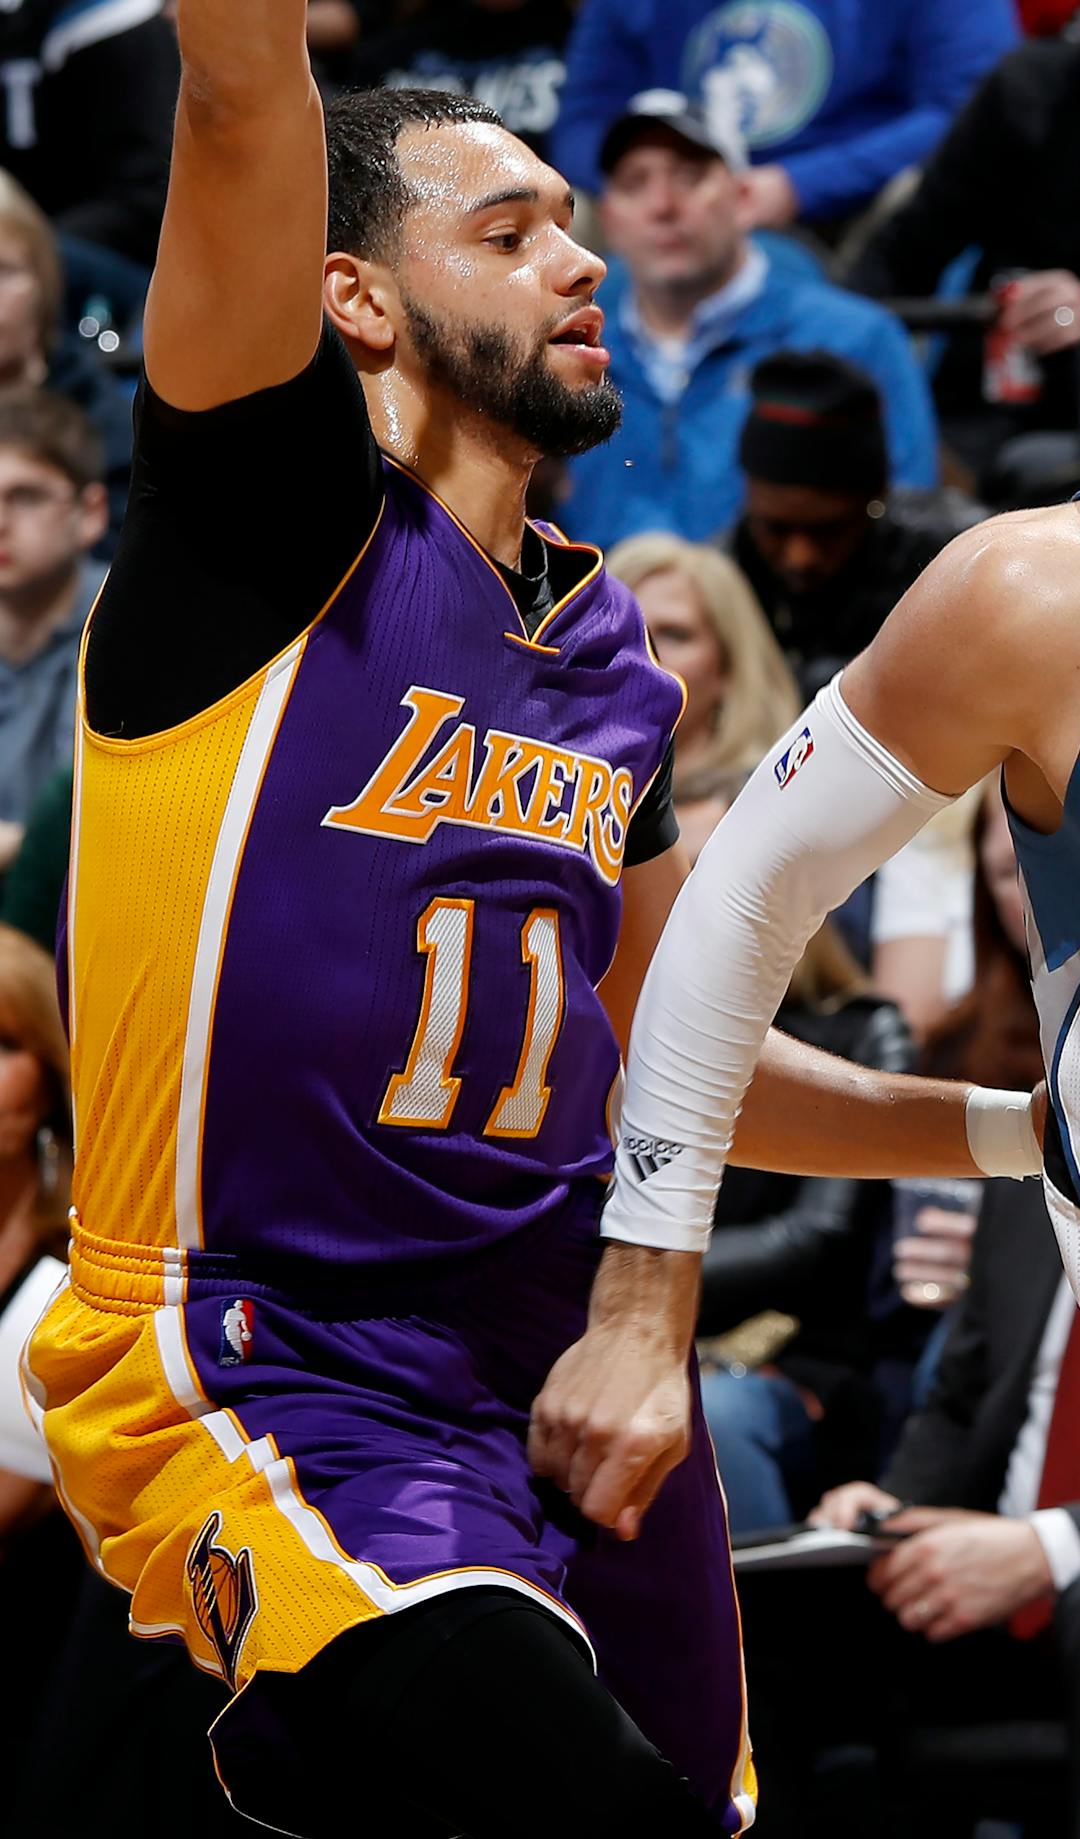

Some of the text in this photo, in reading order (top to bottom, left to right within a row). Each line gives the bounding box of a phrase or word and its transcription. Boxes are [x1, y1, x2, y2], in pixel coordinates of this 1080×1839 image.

[320, 685, 634, 887] LAKERS
[376, 896, 565, 1139] 11
[623, 1136, 683, 1157] adidas
